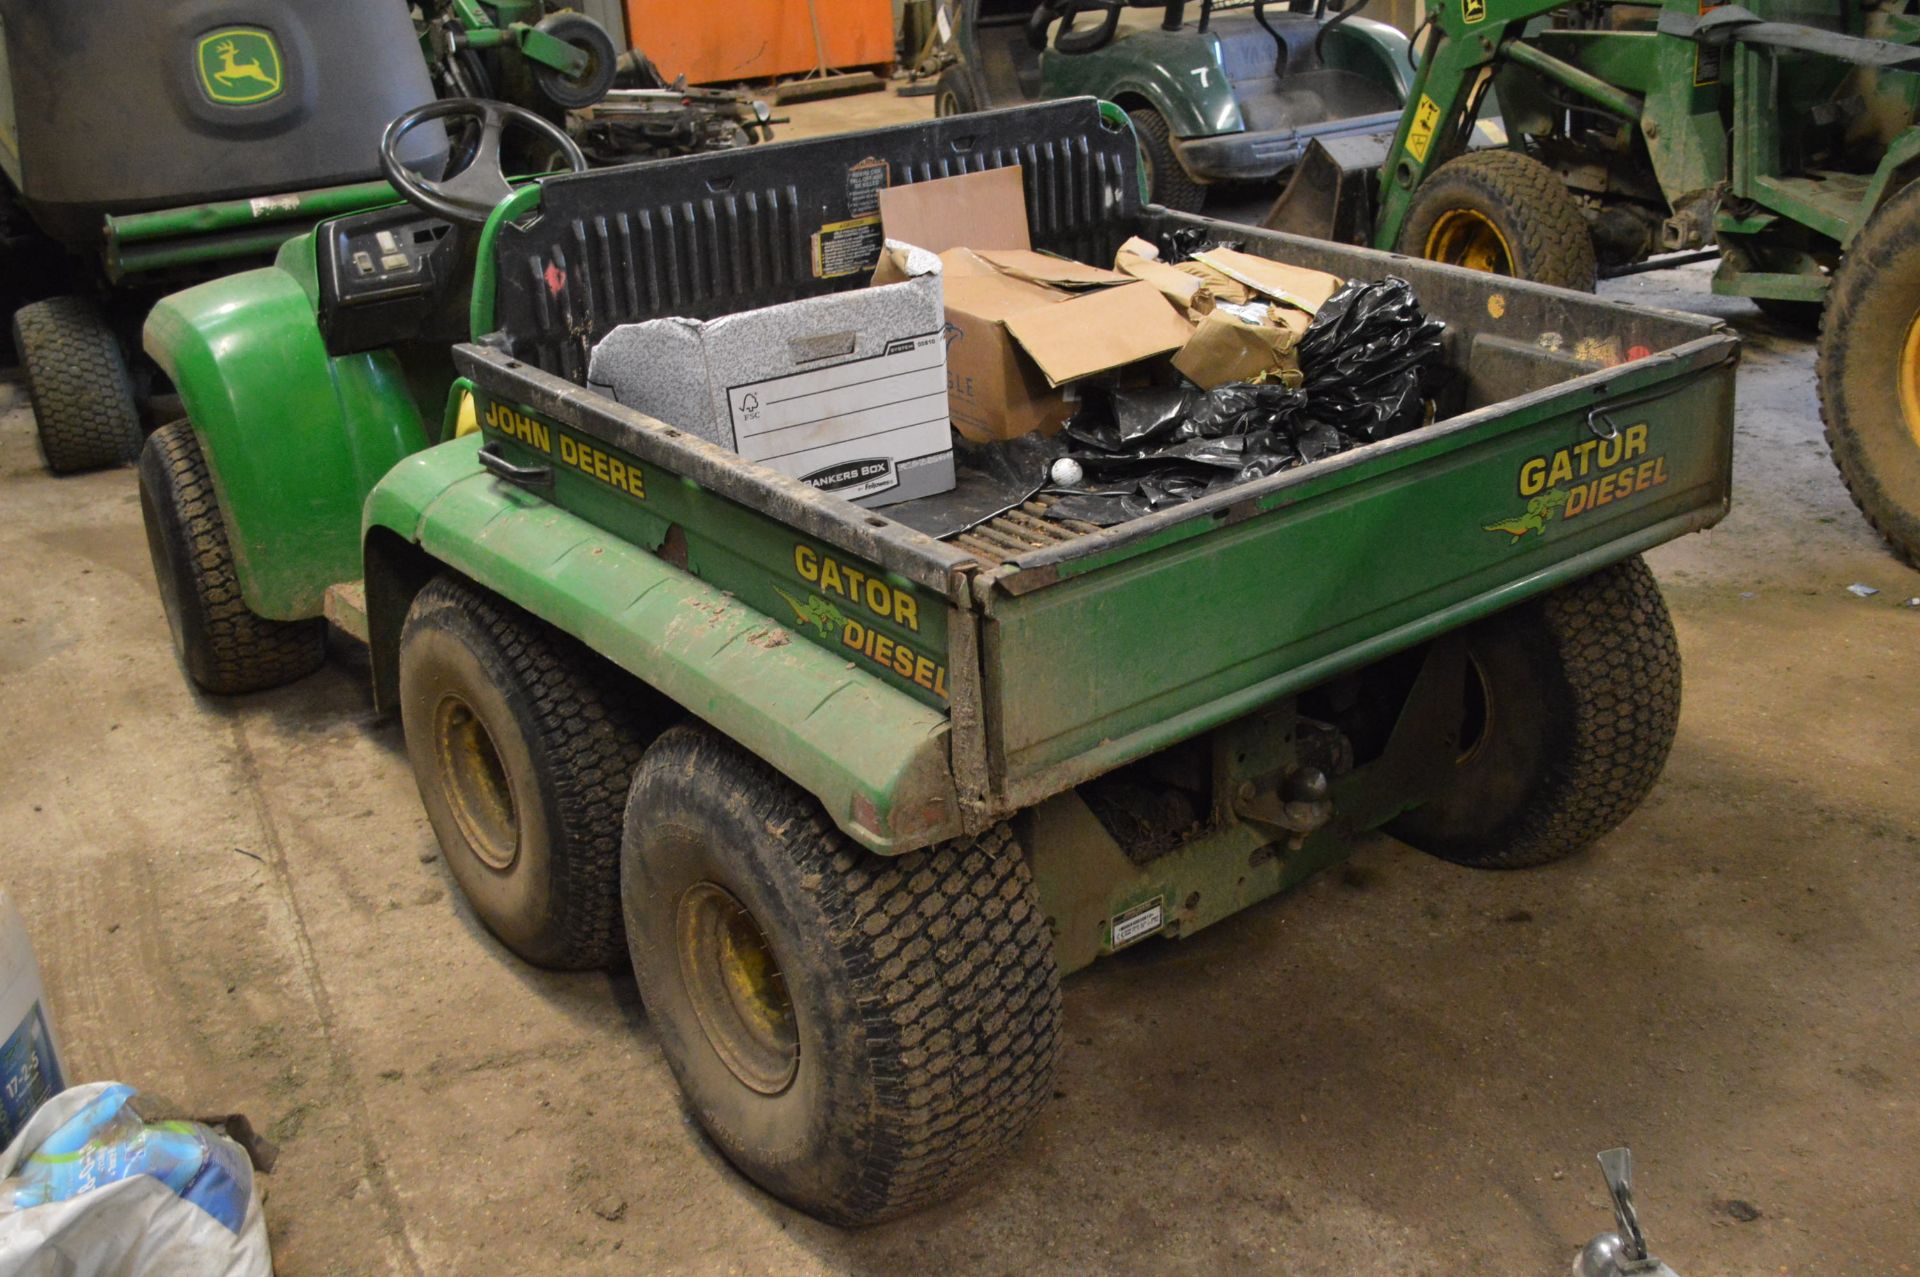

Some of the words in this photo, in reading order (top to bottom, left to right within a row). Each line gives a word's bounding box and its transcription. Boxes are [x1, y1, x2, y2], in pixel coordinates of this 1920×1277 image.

[1190, 67, 1208, 88] 7
[744, 411, 761, 422] FSC
[485, 400, 550, 453] JOHN
[559, 433, 645, 499] DEERE
[861, 462, 886, 476] BOX
[1519, 423, 1648, 497] GATOR
[1563, 456, 1668, 519] DIESEL
[794, 543, 919, 631] GATOR
[842, 618, 949, 700] DIESEL
[5, 1052, 39, 1099] 17-2-5
